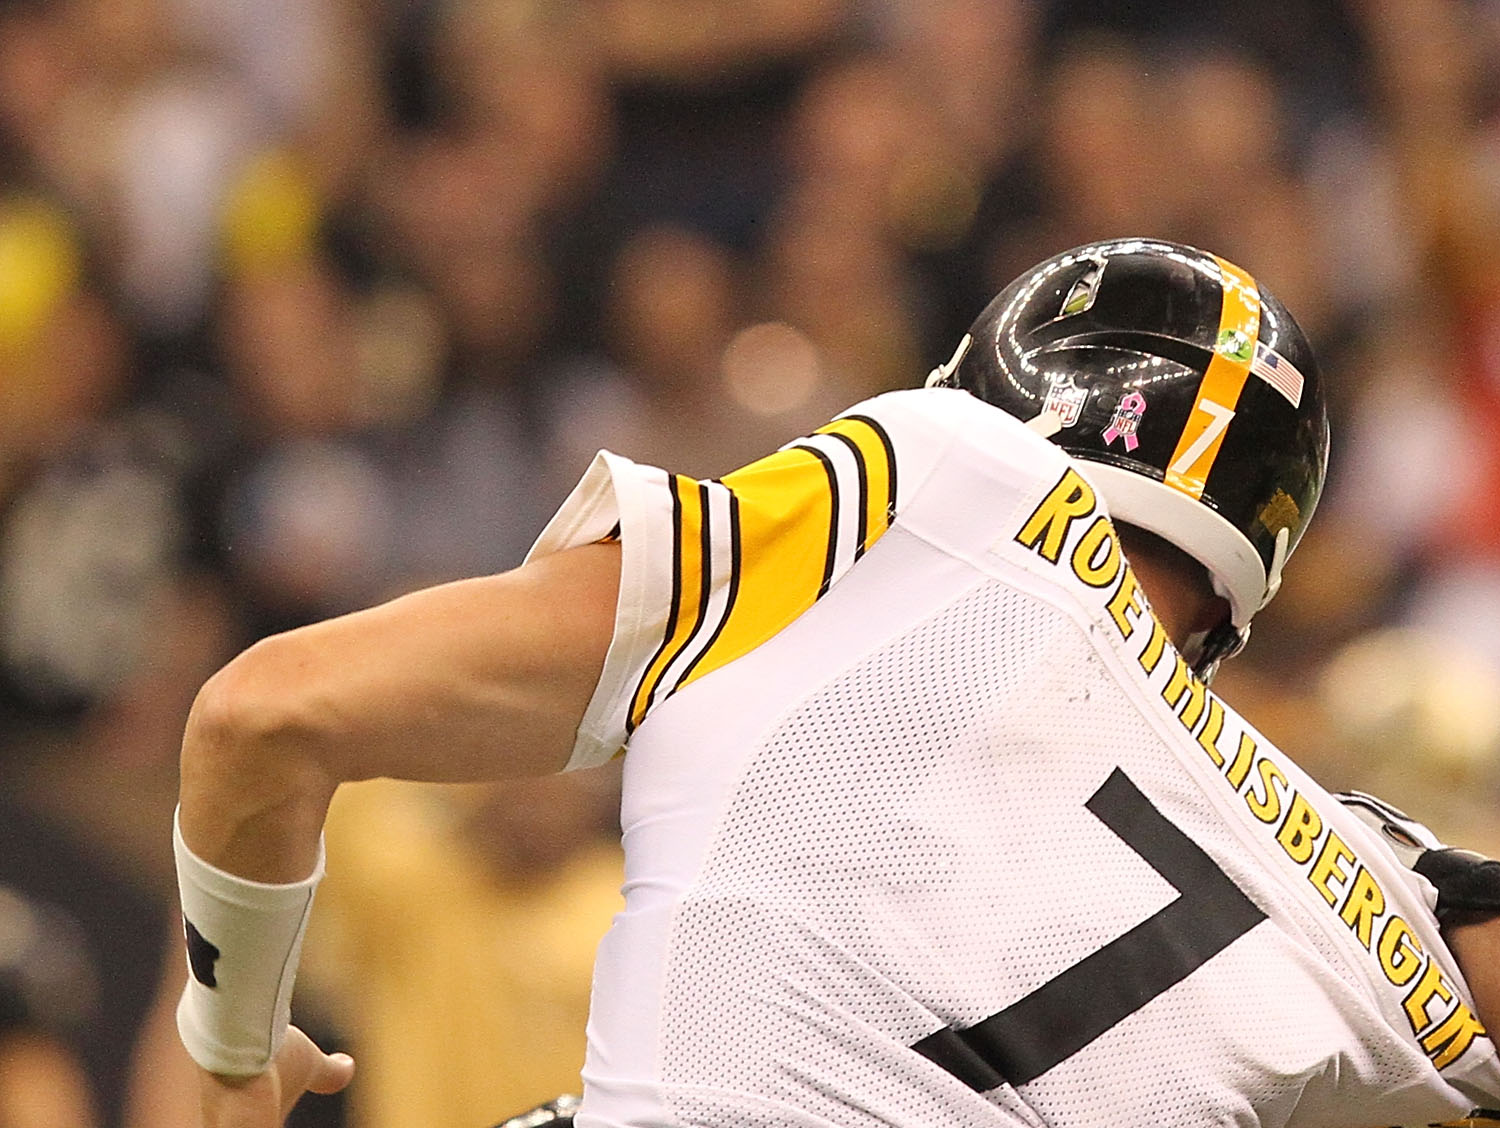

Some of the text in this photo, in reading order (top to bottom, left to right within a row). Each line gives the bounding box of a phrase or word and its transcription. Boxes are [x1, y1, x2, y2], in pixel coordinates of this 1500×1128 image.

[1114, 417, 1135, 433] NFL
[1170, 399, 1237, 475] 7
[1013, 466, 1491, 1072] ROETHLISBERGER
[908, 765, 1270, 1093] 7
